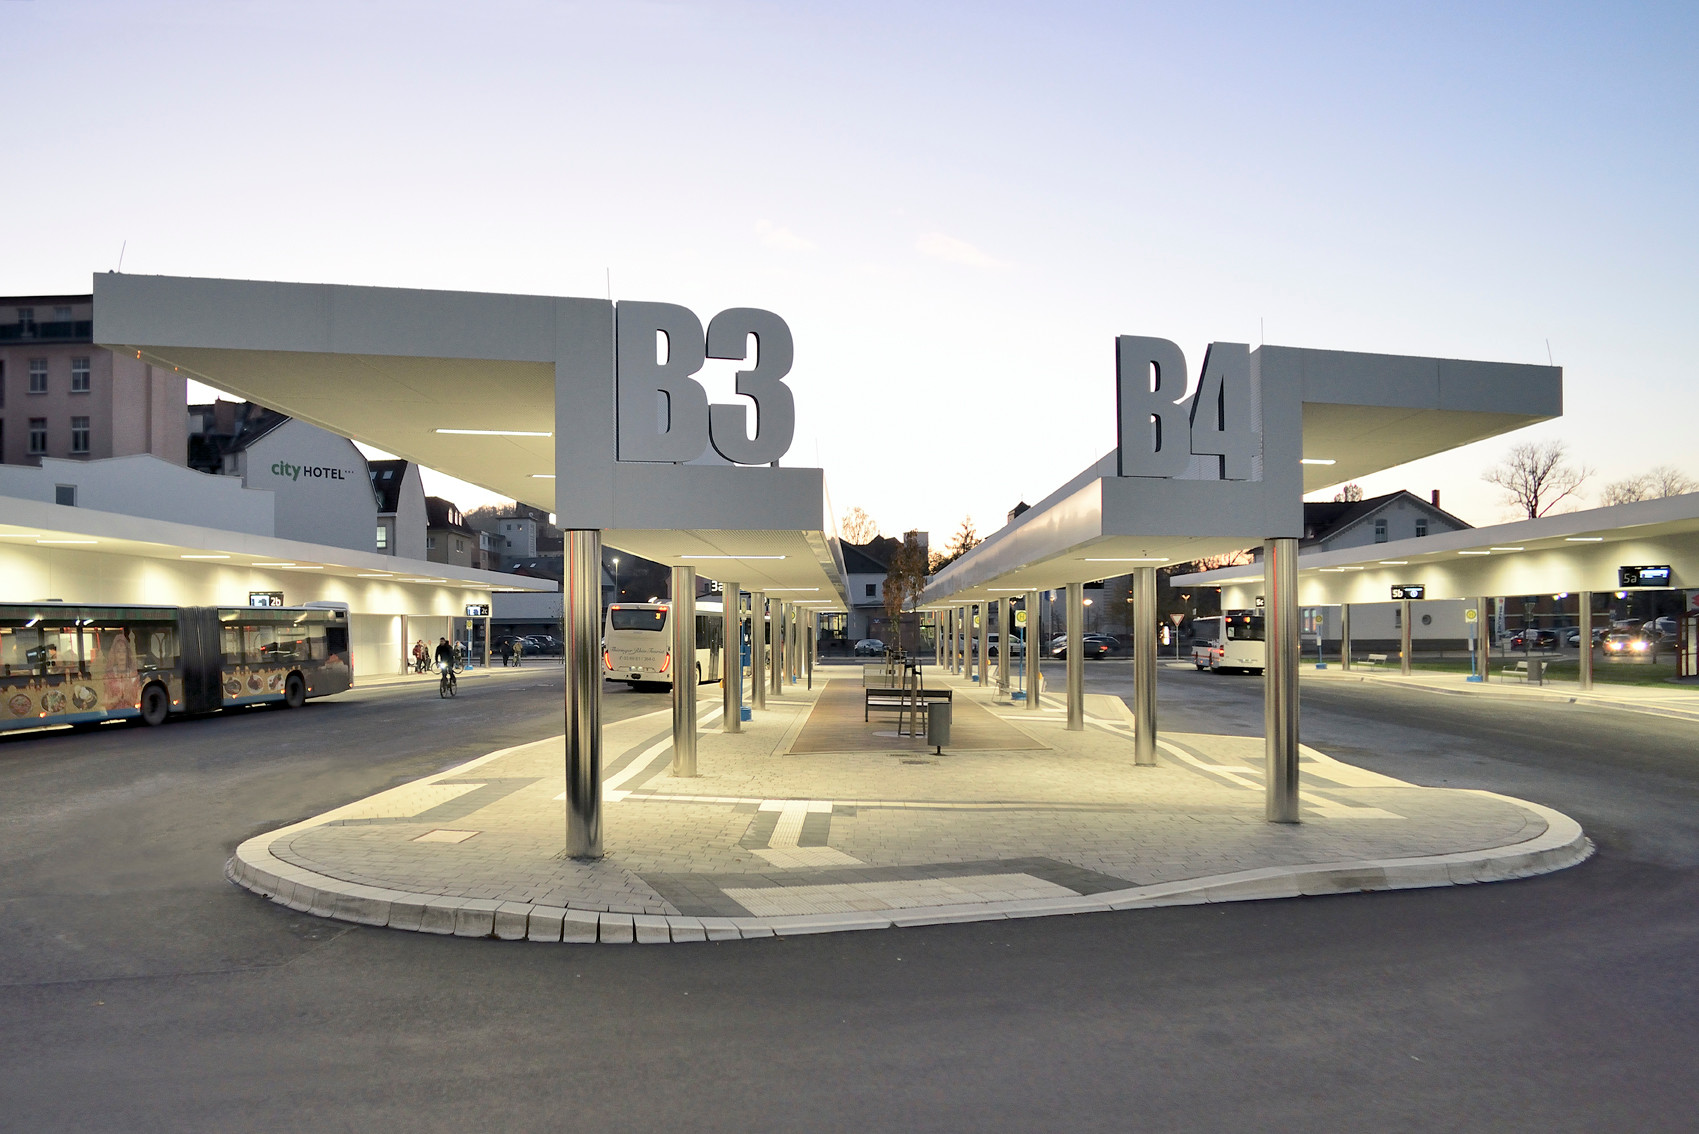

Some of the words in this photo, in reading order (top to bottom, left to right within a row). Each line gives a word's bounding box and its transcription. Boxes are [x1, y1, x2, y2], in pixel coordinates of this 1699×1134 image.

[615, 300, 795, 466] B3
[1115, 334, 1261, 480] B4
[271, 460, 301, 481] city
[303, 465, 345, 480] HOTEL
[1623, 573, 1638, 584] 5a
[270, 596, 282, 606] 2b
[1392, 588, 1404, 598] 5b
